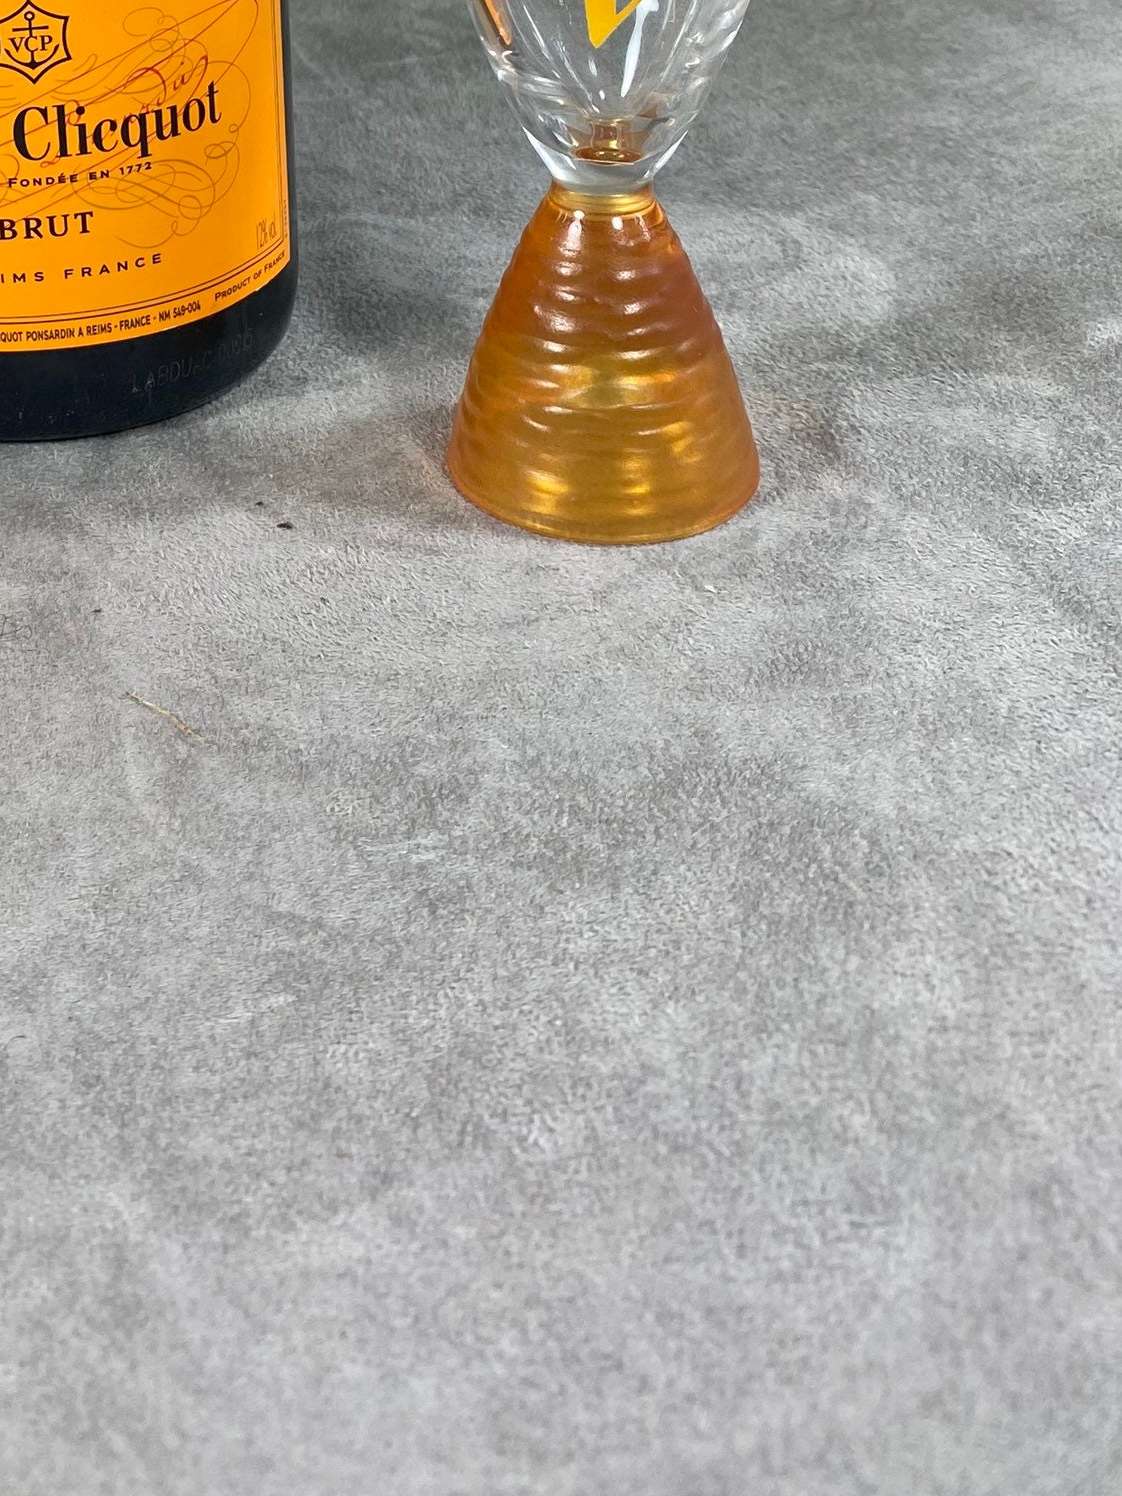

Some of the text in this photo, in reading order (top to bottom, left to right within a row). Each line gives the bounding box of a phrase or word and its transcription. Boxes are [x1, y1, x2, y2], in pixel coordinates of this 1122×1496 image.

[7, 34, 53, 53] VCP
[12, 81, 222, 163] Clicquot
[89, 170, 110, 181] EN
[119, 162, 152, 175] 1772
[65, 253, 162, 280] FRANCE
[25, 328, 75, 342] PONSARDIN
[86, 323, 112, 336] REIMS
[119, 317, 151, 331] FRANCE
[158, 310, 171, 322] NM
